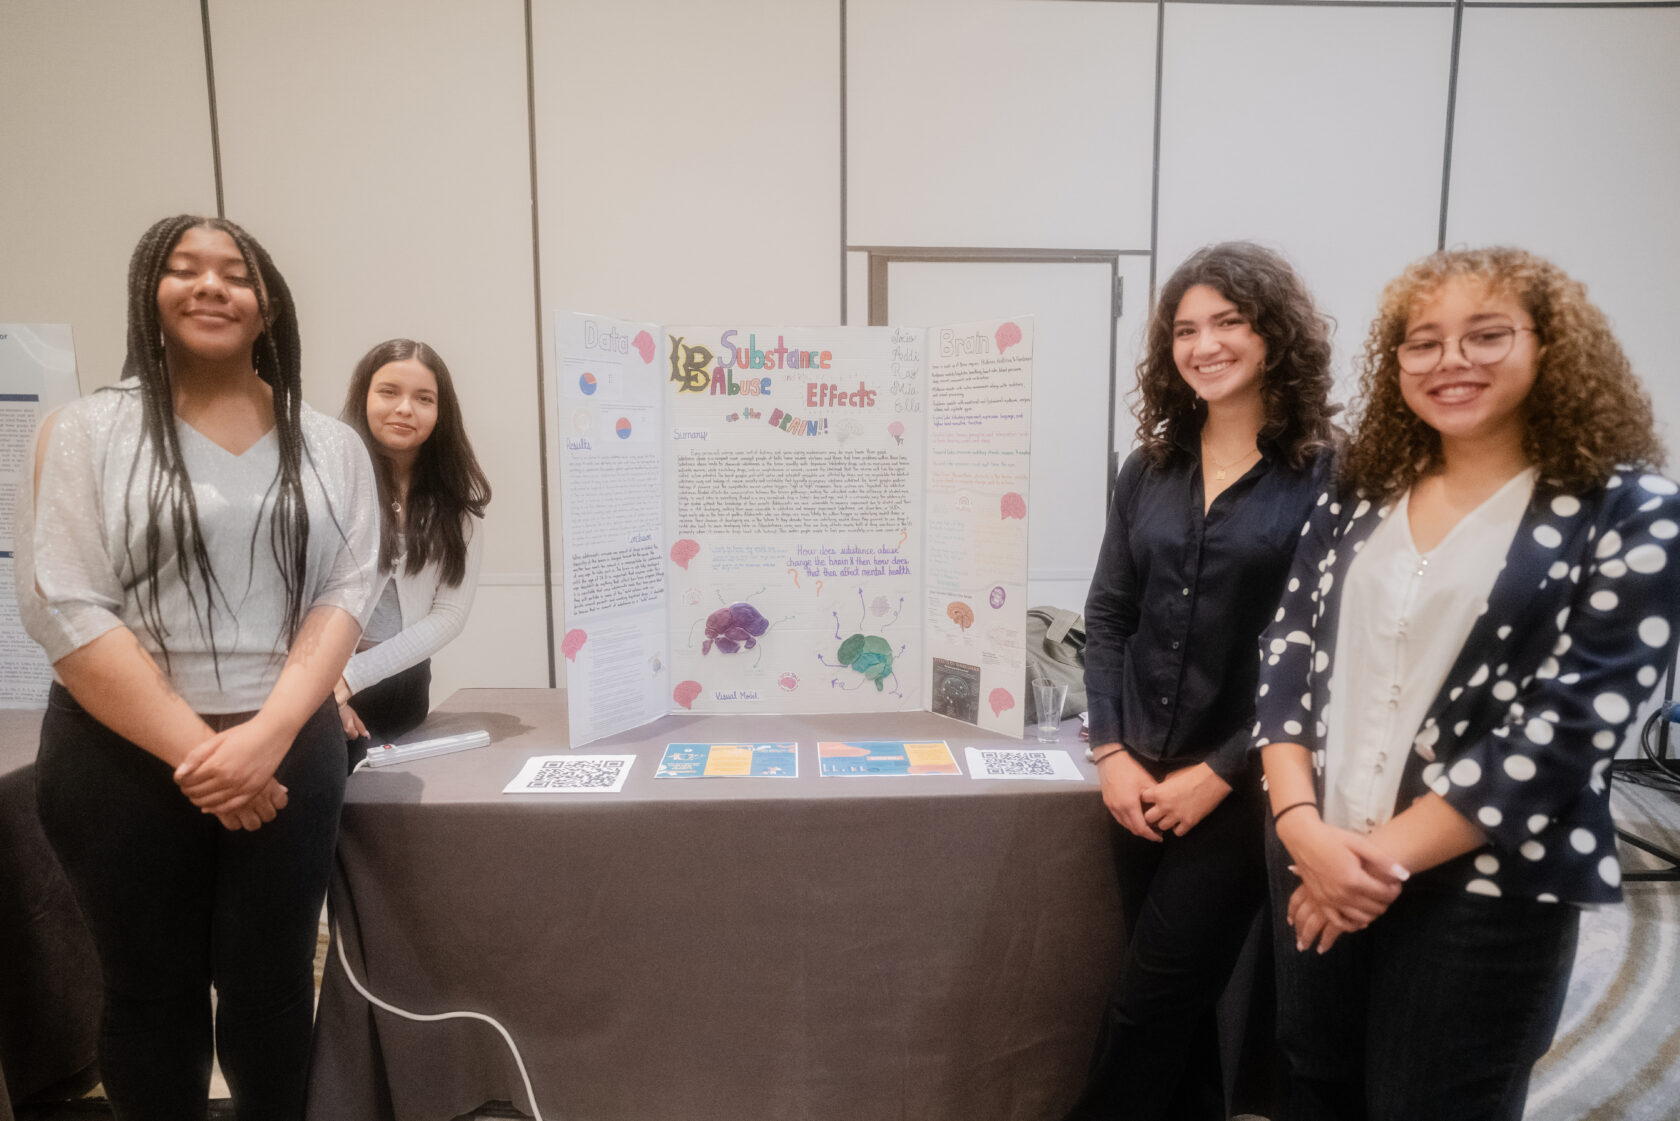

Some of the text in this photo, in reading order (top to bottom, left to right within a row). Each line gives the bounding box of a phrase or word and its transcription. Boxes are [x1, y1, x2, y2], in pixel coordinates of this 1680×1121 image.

[584, 321, 629, 354] Data
[940, 328, 990, 358] Brain
[718, 330, 832, 369] Substance
[710, 366, 772, 396] Abuse
[806, 381, 877, 408] Effects
[743, 407, 762, 420] the
[798, 544, 899, 556] How does substance abuse
[786, 557, 812, 569] change
[814, 557, 826, 566] the
[828, 556, 849, 566] brain
[856, 556, 872, 566] then
[873, 556, 889, 566] how
[862, 566, 886, 576] mental
[888, 565, 912, 575] health
[715, 691, 738, 701] Visual
